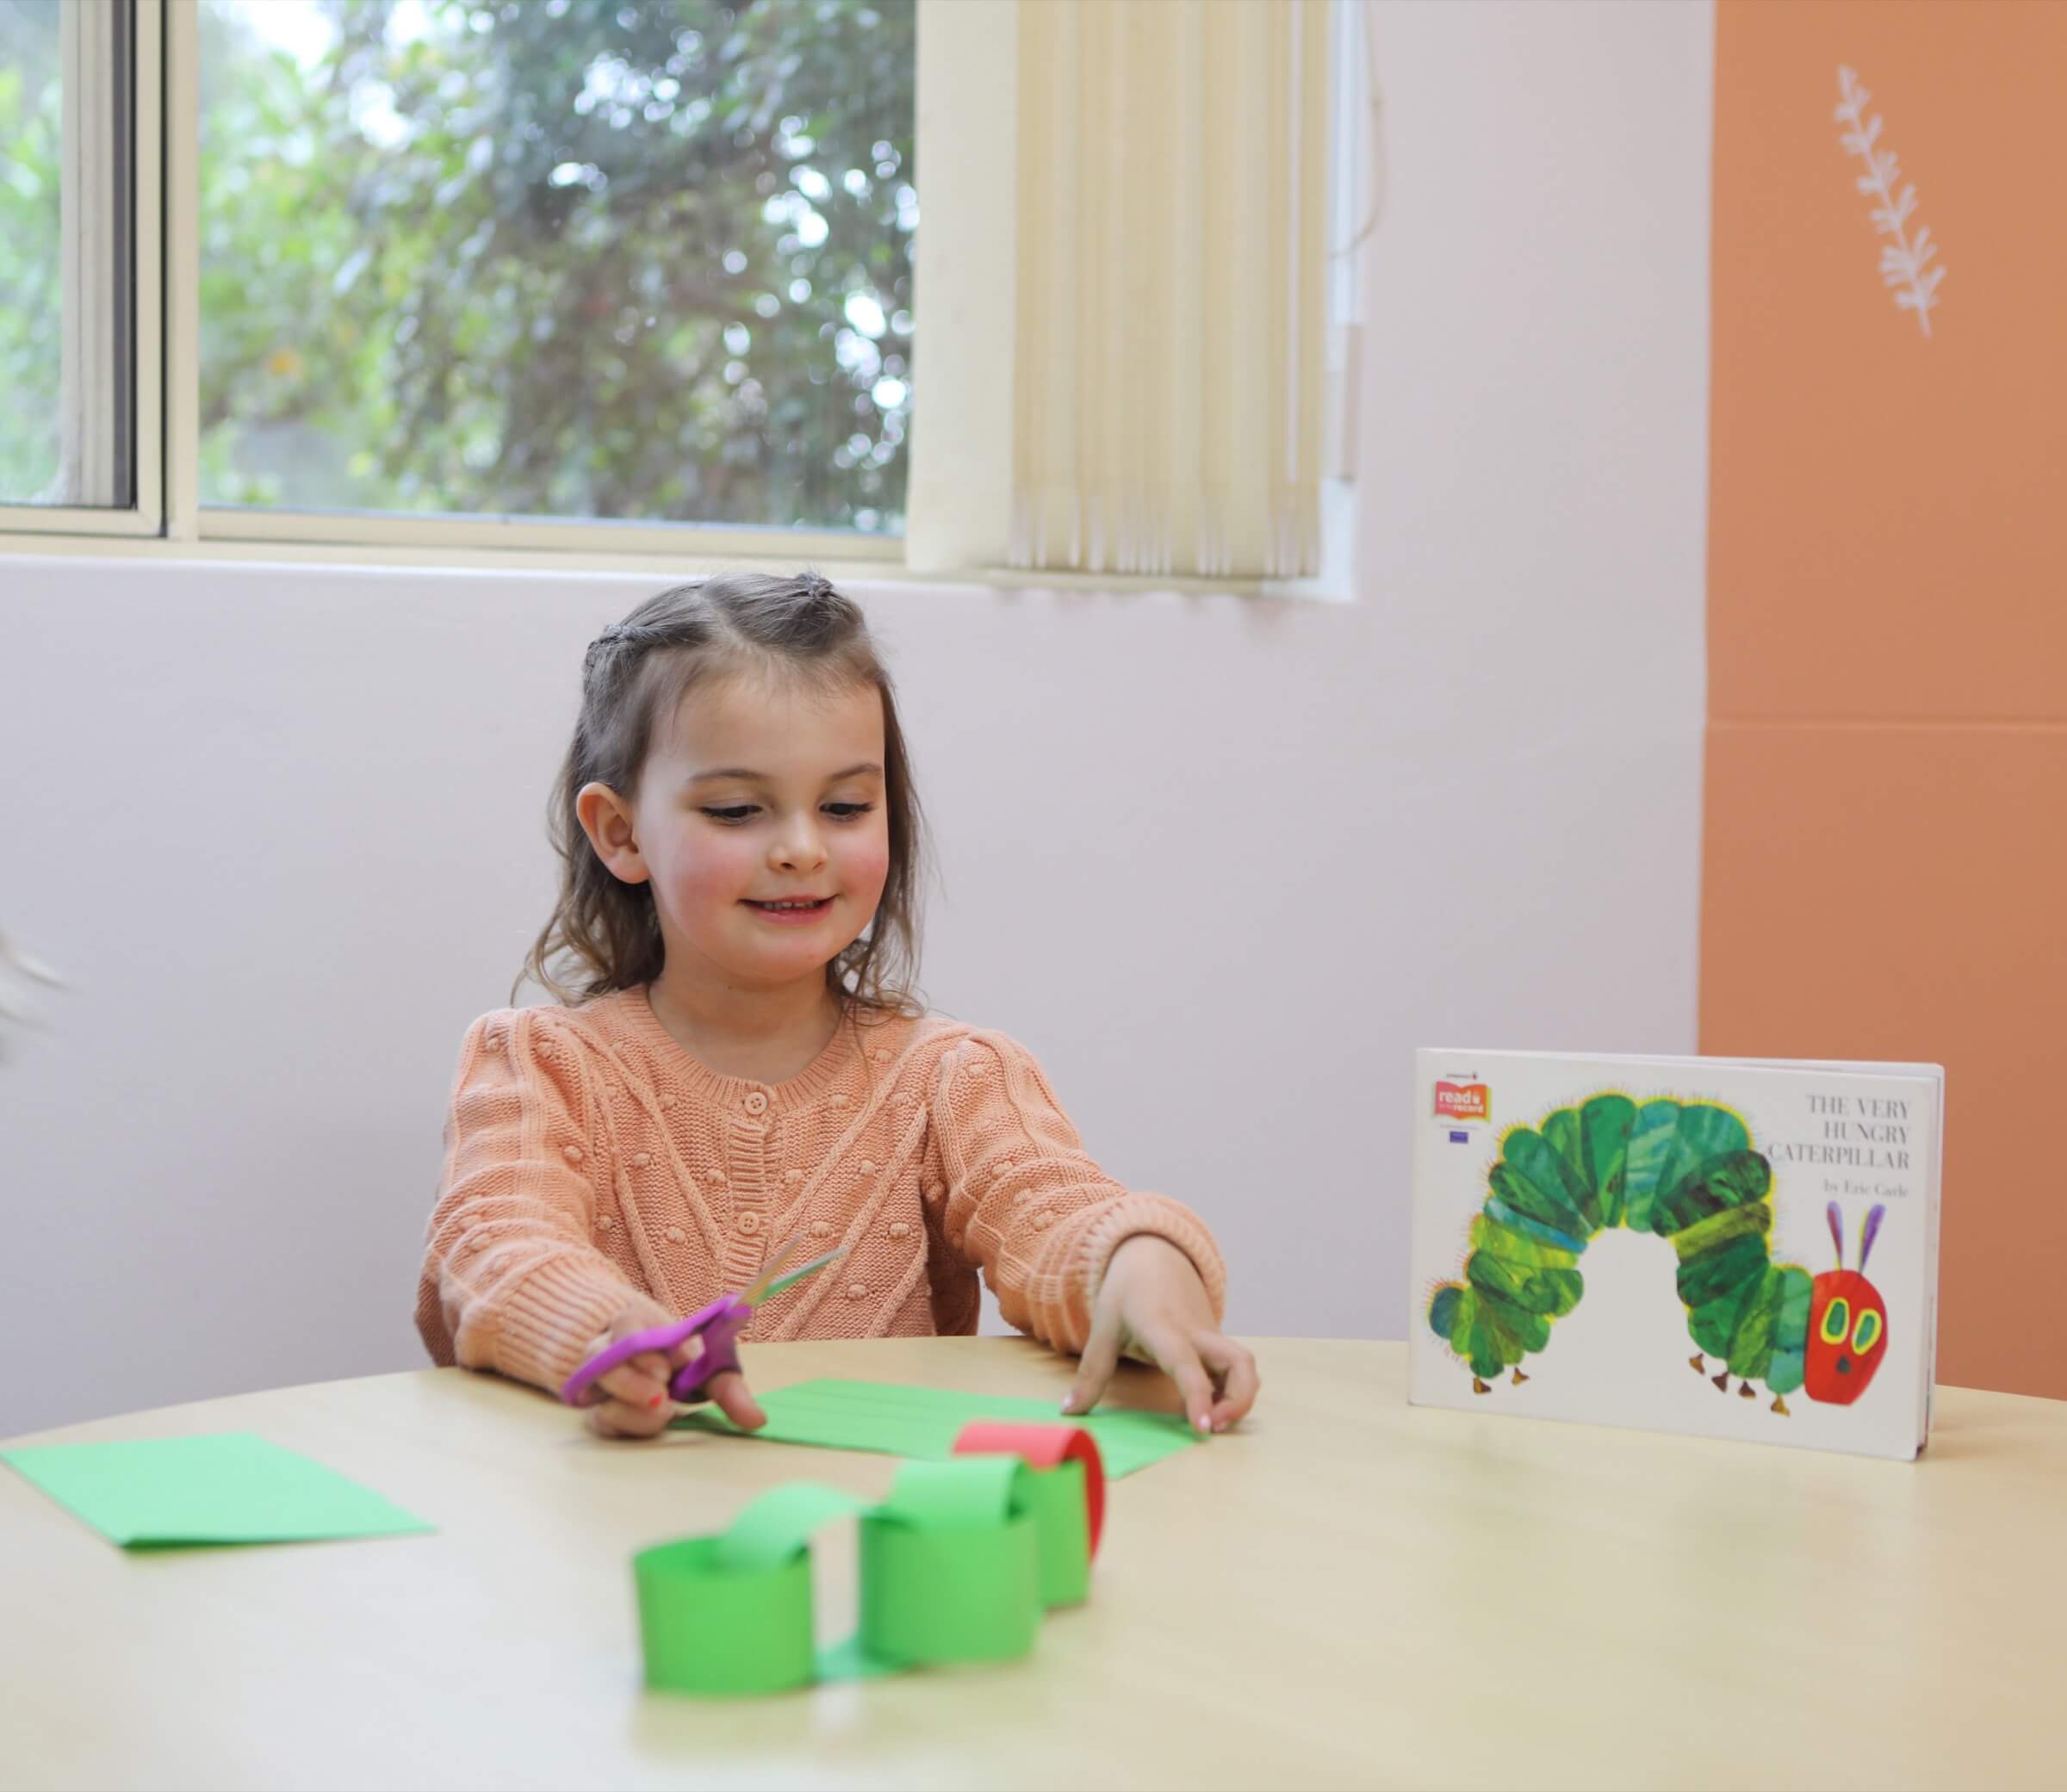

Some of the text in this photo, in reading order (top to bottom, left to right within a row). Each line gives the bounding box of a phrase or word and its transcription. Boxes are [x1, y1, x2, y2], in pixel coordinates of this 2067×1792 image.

[1440, 1090, 1471, 1104] read
[1806, 1094, 1910, 1119] THE VERY
[1824, 1120, 1909, 1144] HUNGRY
[1766, 1144, 1910, 1169] CATERPILLAR
[1824, 1178, 1909, 1198] by Eric Carle
